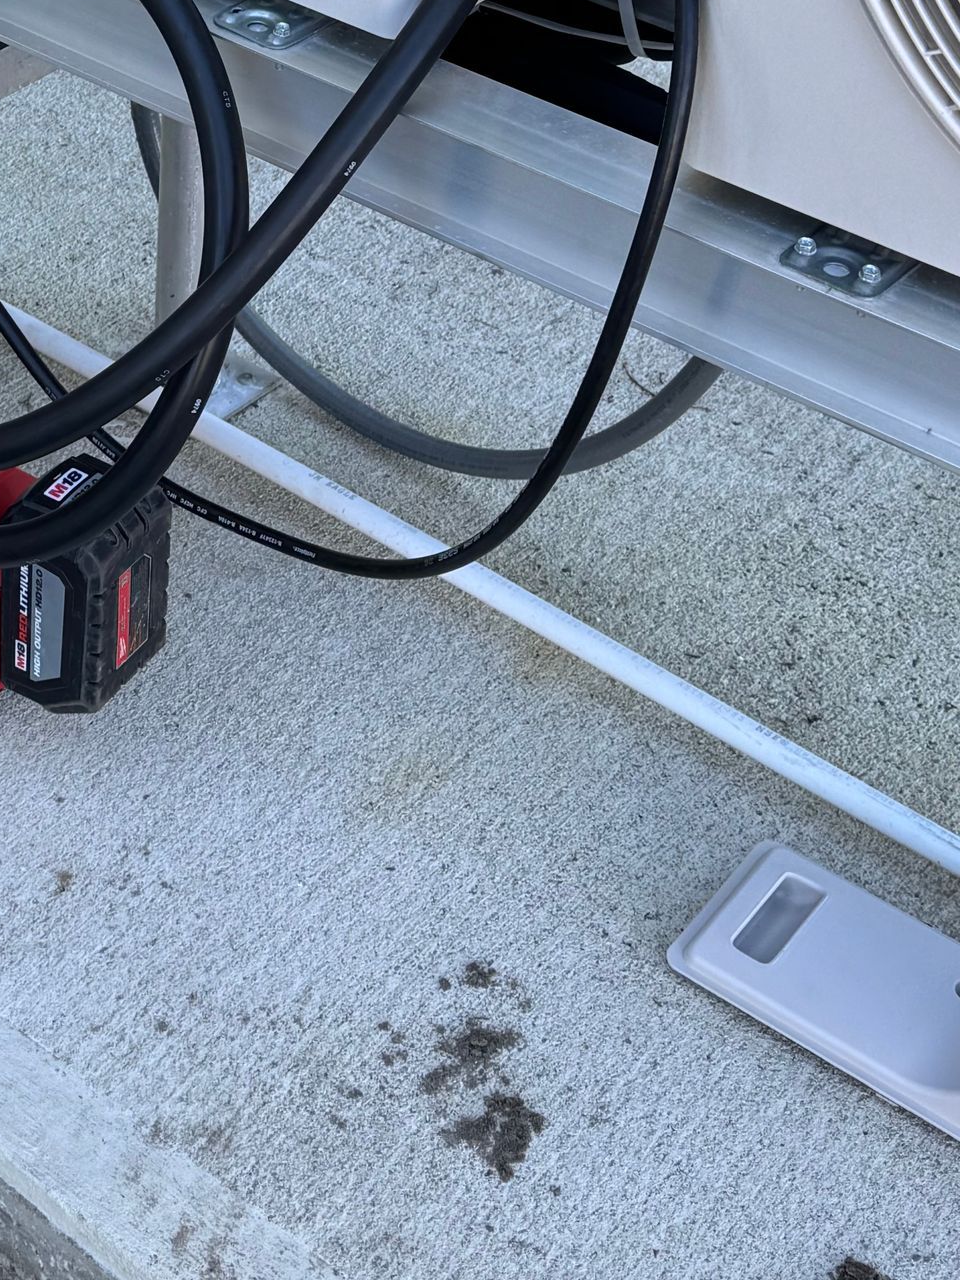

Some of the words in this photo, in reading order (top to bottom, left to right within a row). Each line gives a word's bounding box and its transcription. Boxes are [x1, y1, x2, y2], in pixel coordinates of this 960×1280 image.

[48, 471, 82, 498] M18
[324, 480, 357, 501] EAGLE
[180, 498, 193, 507] HCFC
[197, 506, 206, 514] CFC
[239, 525, 255, 535] R-134A
[35, 570, 43, 608] HD12.0
[34, 608, 43, 652] OUTPUT
[17, 646, 25, 669] M18
[33, 654, 41, 676] HIGH
